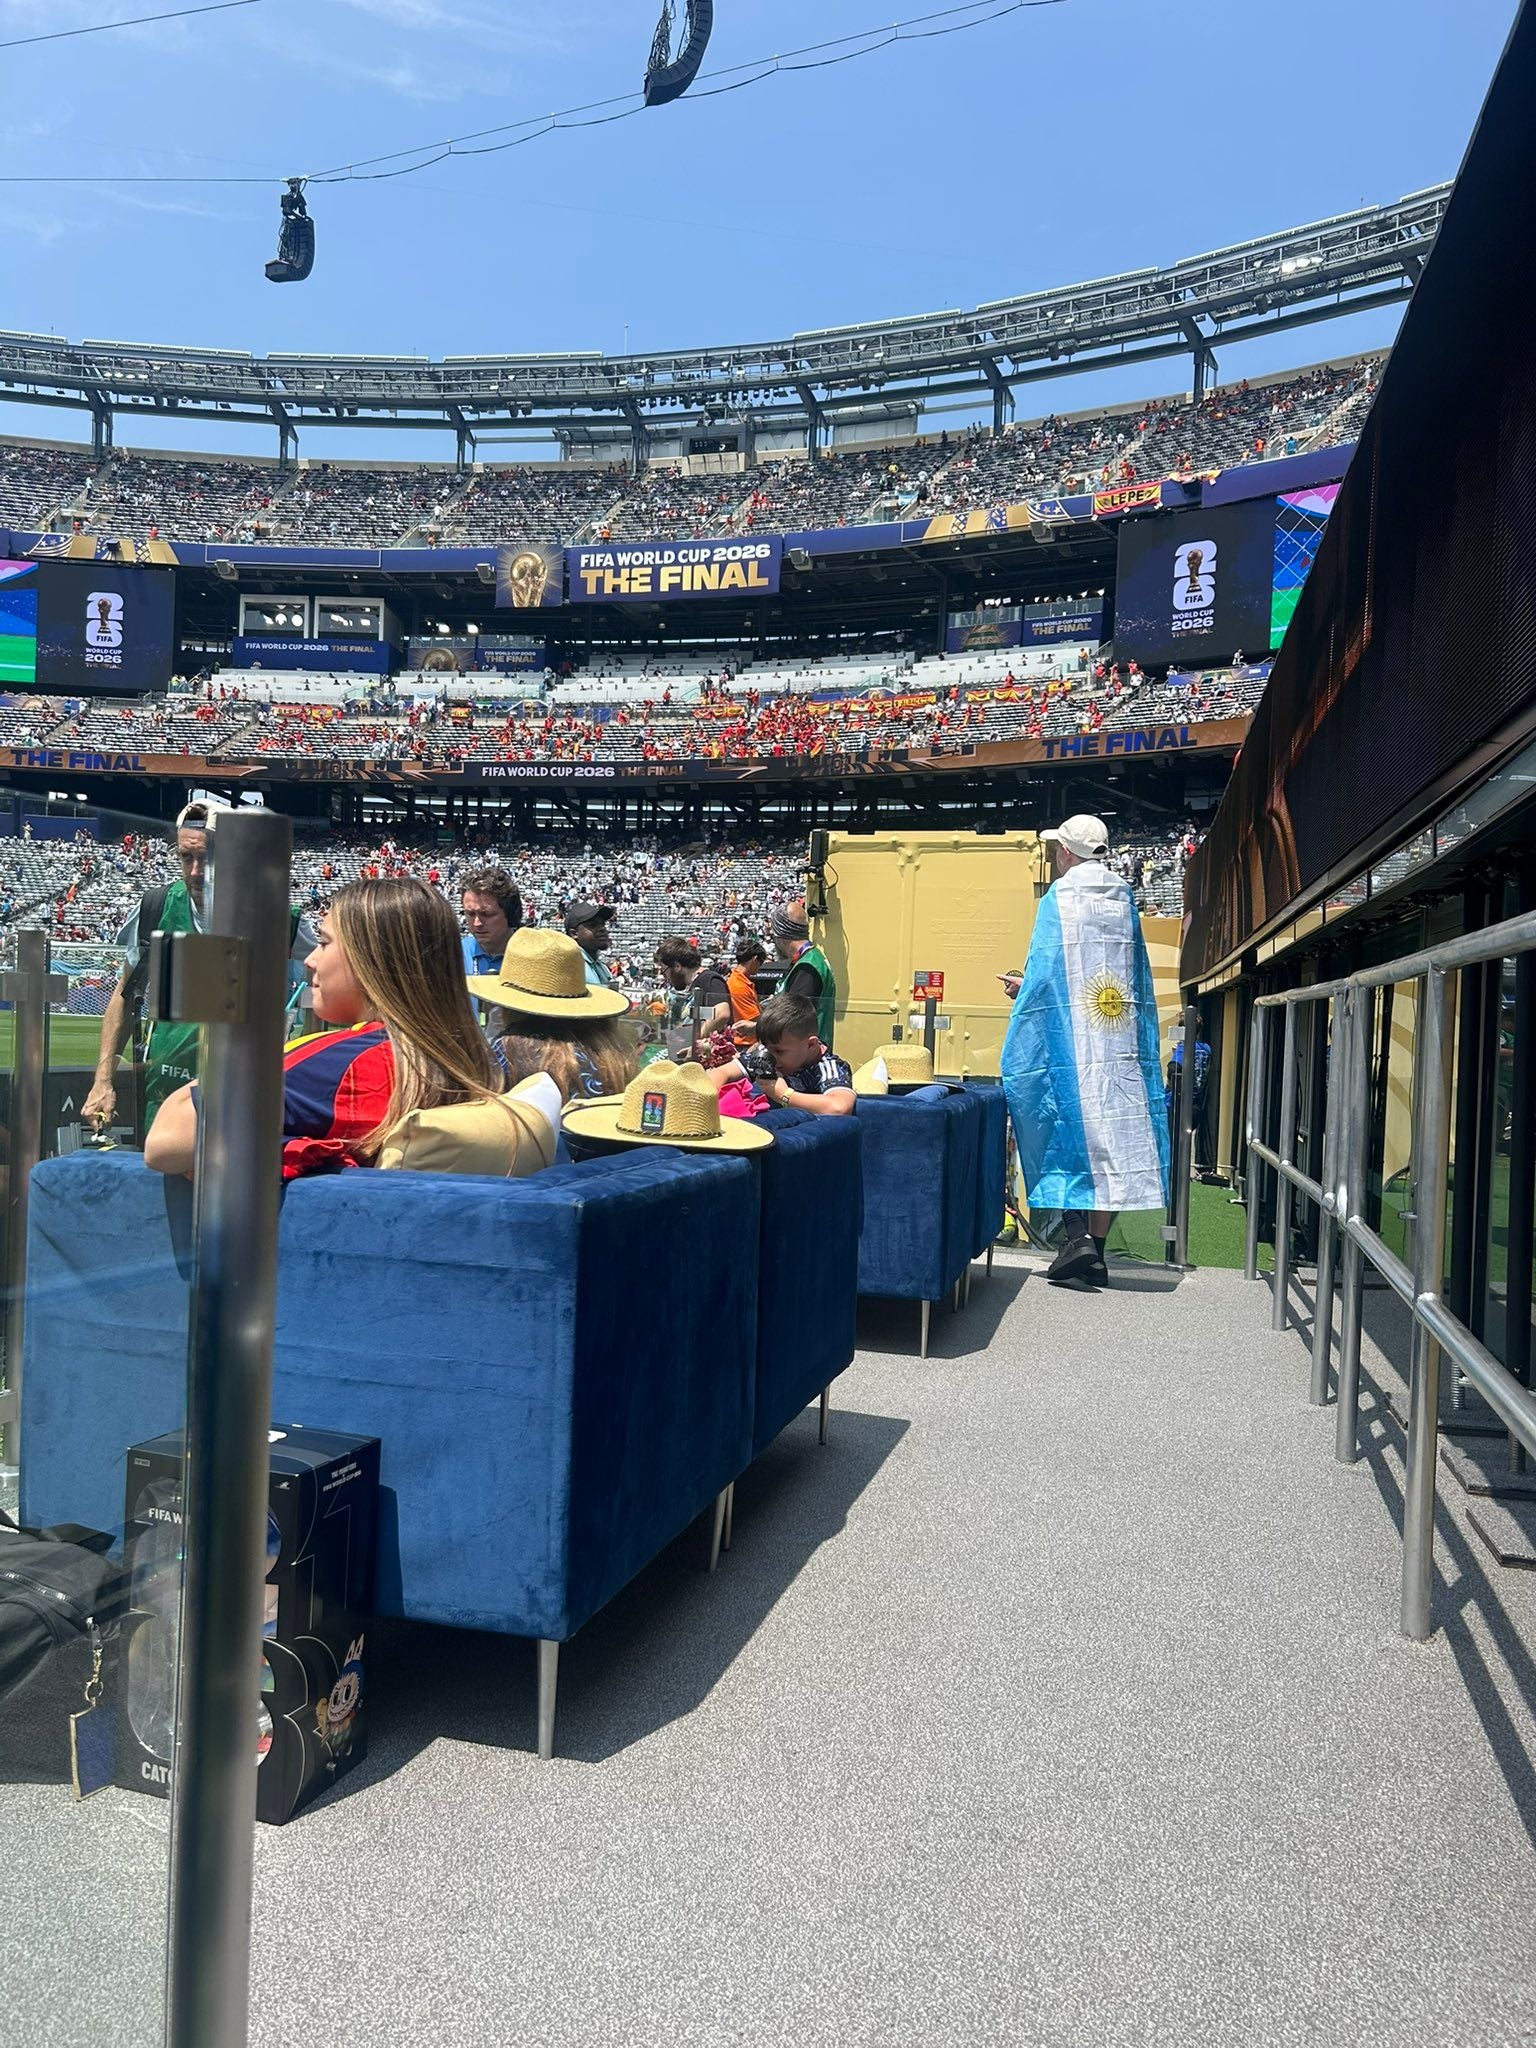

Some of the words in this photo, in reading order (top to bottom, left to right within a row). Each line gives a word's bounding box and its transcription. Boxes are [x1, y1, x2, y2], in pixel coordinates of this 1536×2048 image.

[1111, 490, 1144, 506] LEPE
[581, 553, 615, 568] FIFA
[617, 549, 676, 566] WORLD
[677, 548, 711, 564] CUP
[712, 544, 771, 562] 2026
[580, 567, 653, 595] THE
[660, 561, 769, 592] FINAL
[1184, 595, 1204, 604] FIFA
[1172, 611, 1198, 620] WORLD
[1199, 609, 1215, 617] CUP
[1032, 626, 1055, 636] THE
[1056, 622, 1091, 634] FINAL
[1171, 616, 1214, 631] 2026
[96, 635, 113, 643] FIFA
[349, 645, 375, 653] FINAL
[85, 653, 122, 664] 2026
[485, 655, 505, 663] THE
[506, 655, 535, 663] FINAL
[1042, 735, 1099, 759] THE
[1105, 726, 1197, 754] FINAL
[11, 749, 63, 767] THE
[69, 752, 146, 771] FINAL
[482, 766, 506, 777] FIFA
[508, 766, 548, 777] WORLD
[550, 766, 574, 777] CUP
[574, 766, 615, 777] 2026
[619, 766, 646, 776] THE
[647, 765, 687, 776] FINAL
[148, 1507, 172, 1523] FIFA
